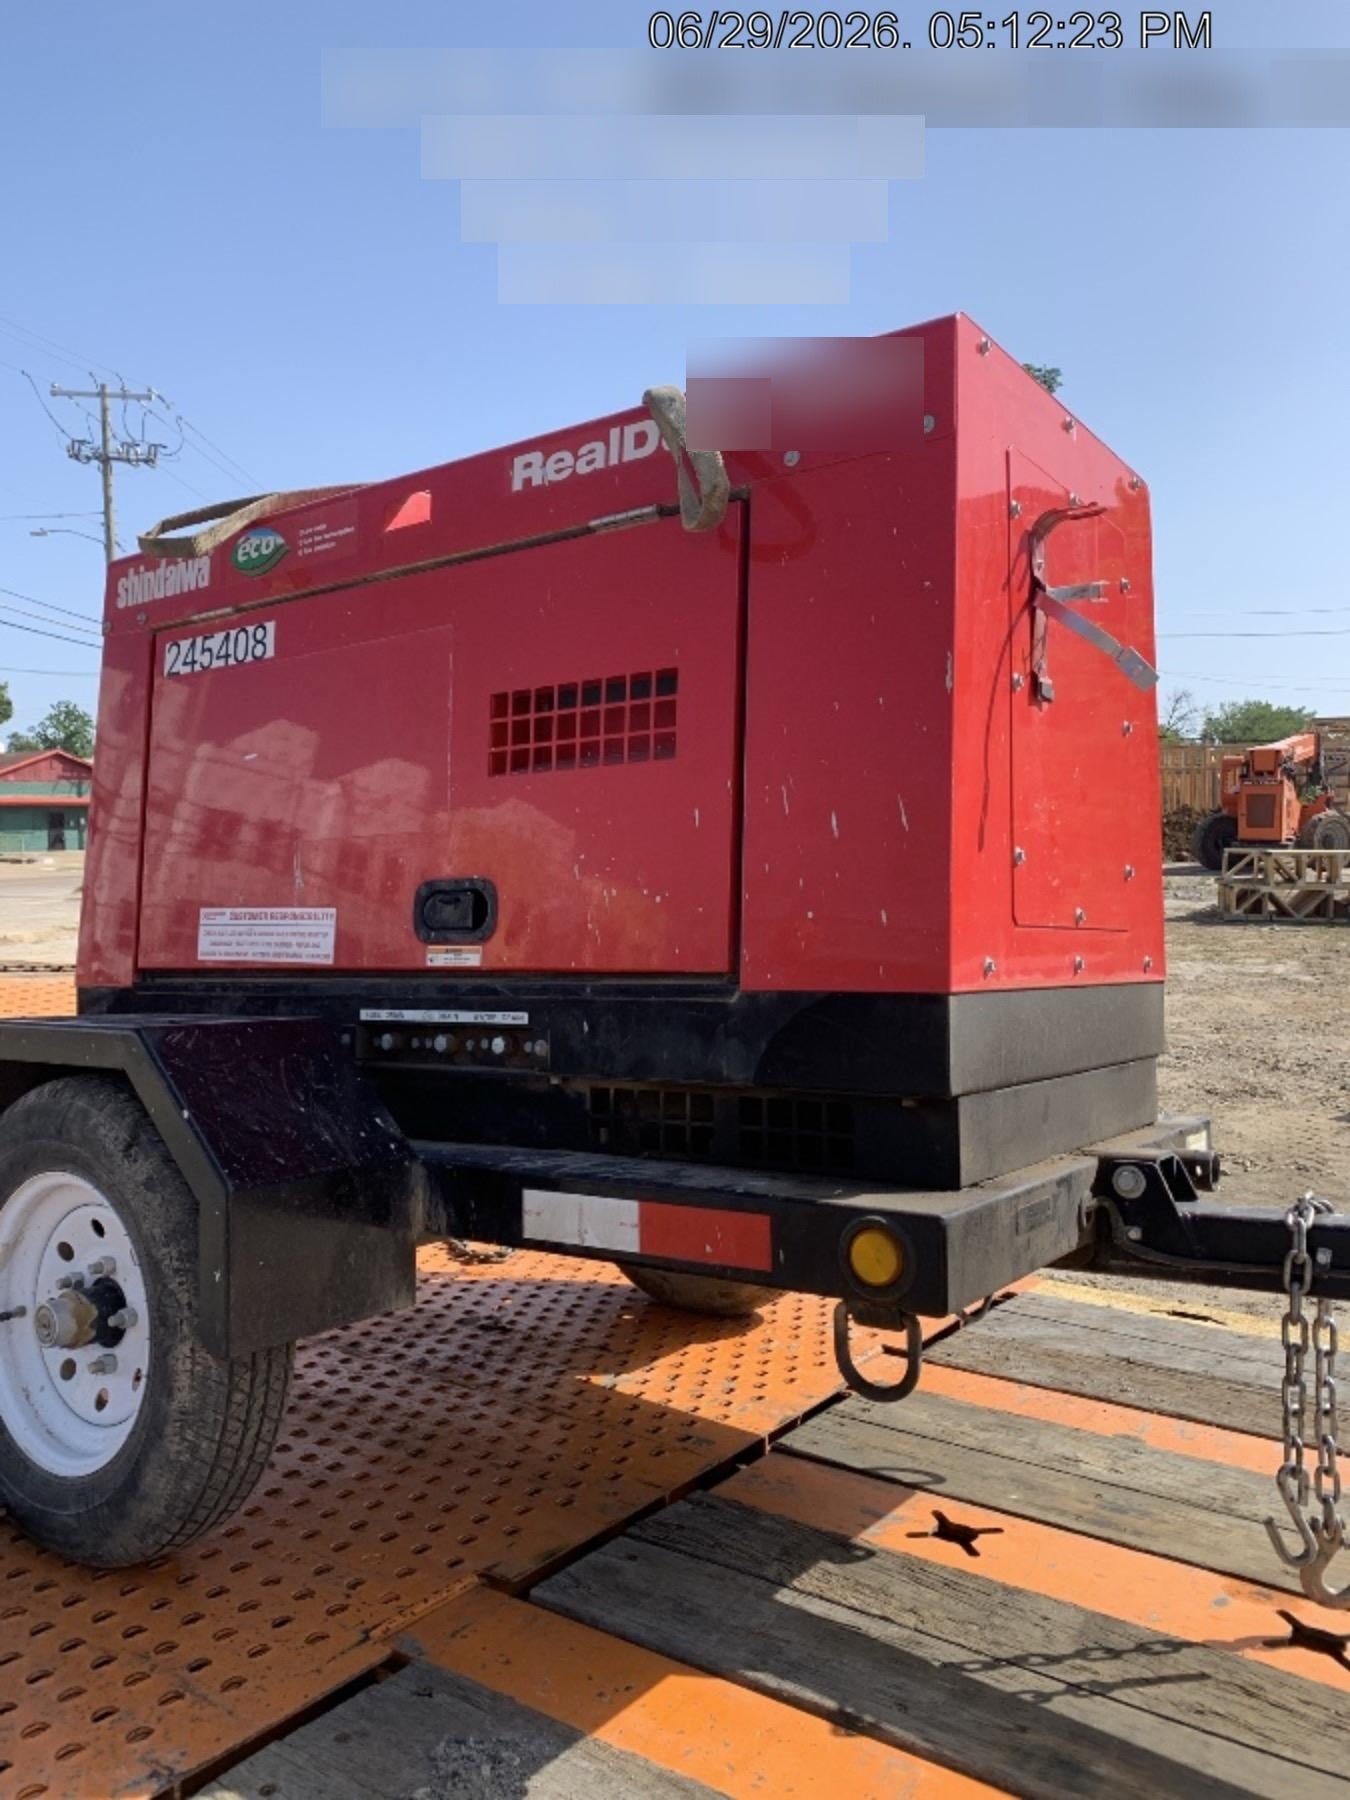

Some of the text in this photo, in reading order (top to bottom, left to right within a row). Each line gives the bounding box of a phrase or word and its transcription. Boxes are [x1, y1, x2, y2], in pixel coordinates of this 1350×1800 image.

[511, 419, 671, 492] RealD
[237, 536, 275, 562] eco
[116, 556, 211, 609] shindaiwa
[167, 624, 268, 678] 245408
